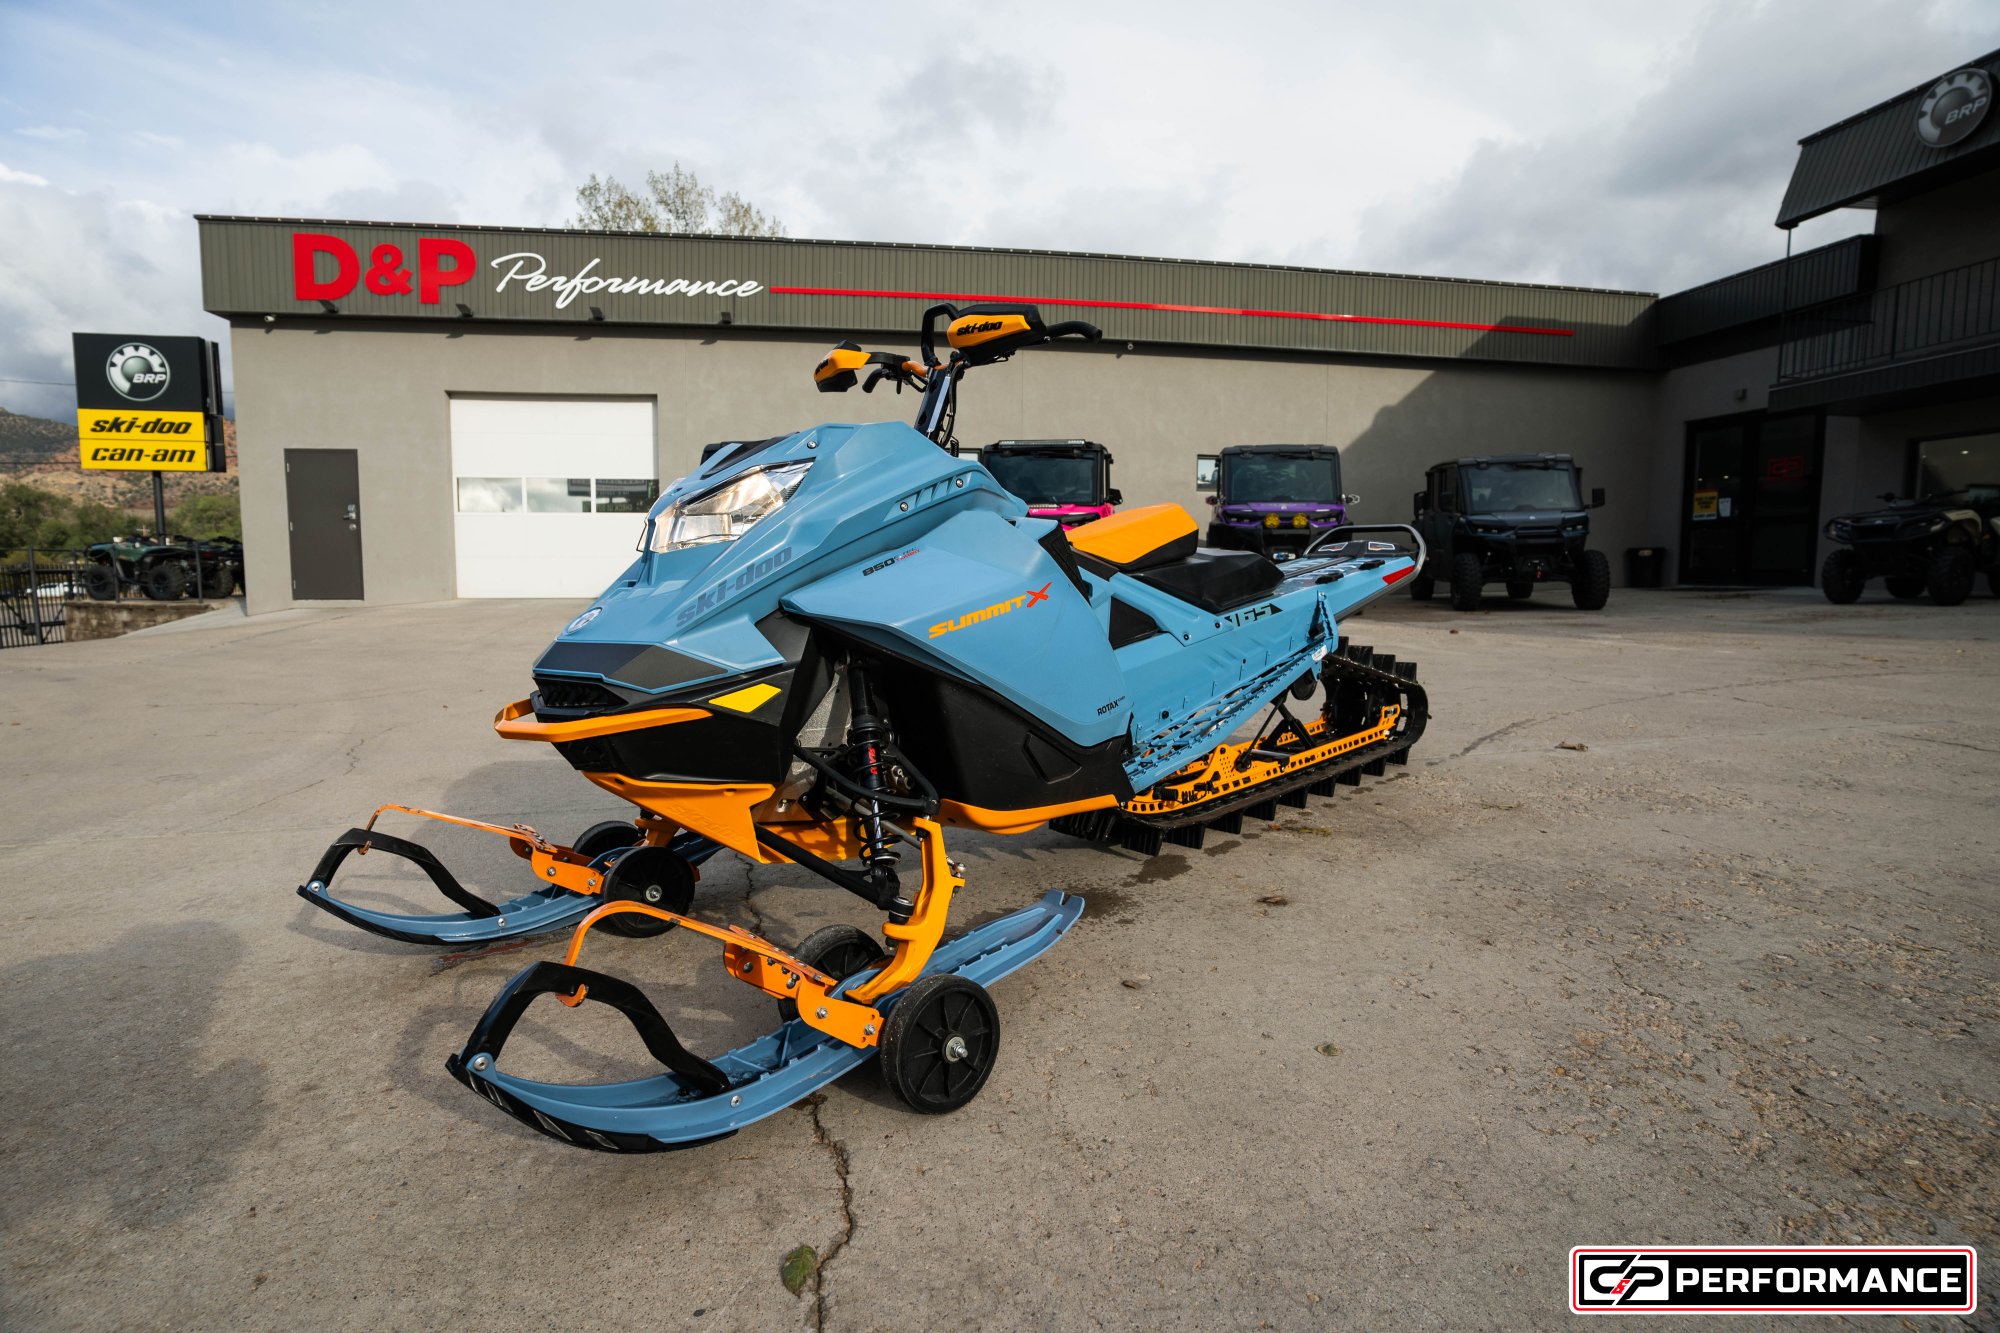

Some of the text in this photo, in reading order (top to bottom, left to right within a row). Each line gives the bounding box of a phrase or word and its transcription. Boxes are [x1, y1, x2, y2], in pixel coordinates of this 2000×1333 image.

[1944, 97, 1987, 124] BRP
[293, 232, 763, 309] D&P Performance
[132, 373, 167, 384] BRP
[90, 416, 192, 434] ski-doo
[91, 447, 196, 463] can-am
[862, 557, 895, 576] 850
[677, 547, 792, 627] ski-doo
[1097, 700, 1119, 716] ROTAX
